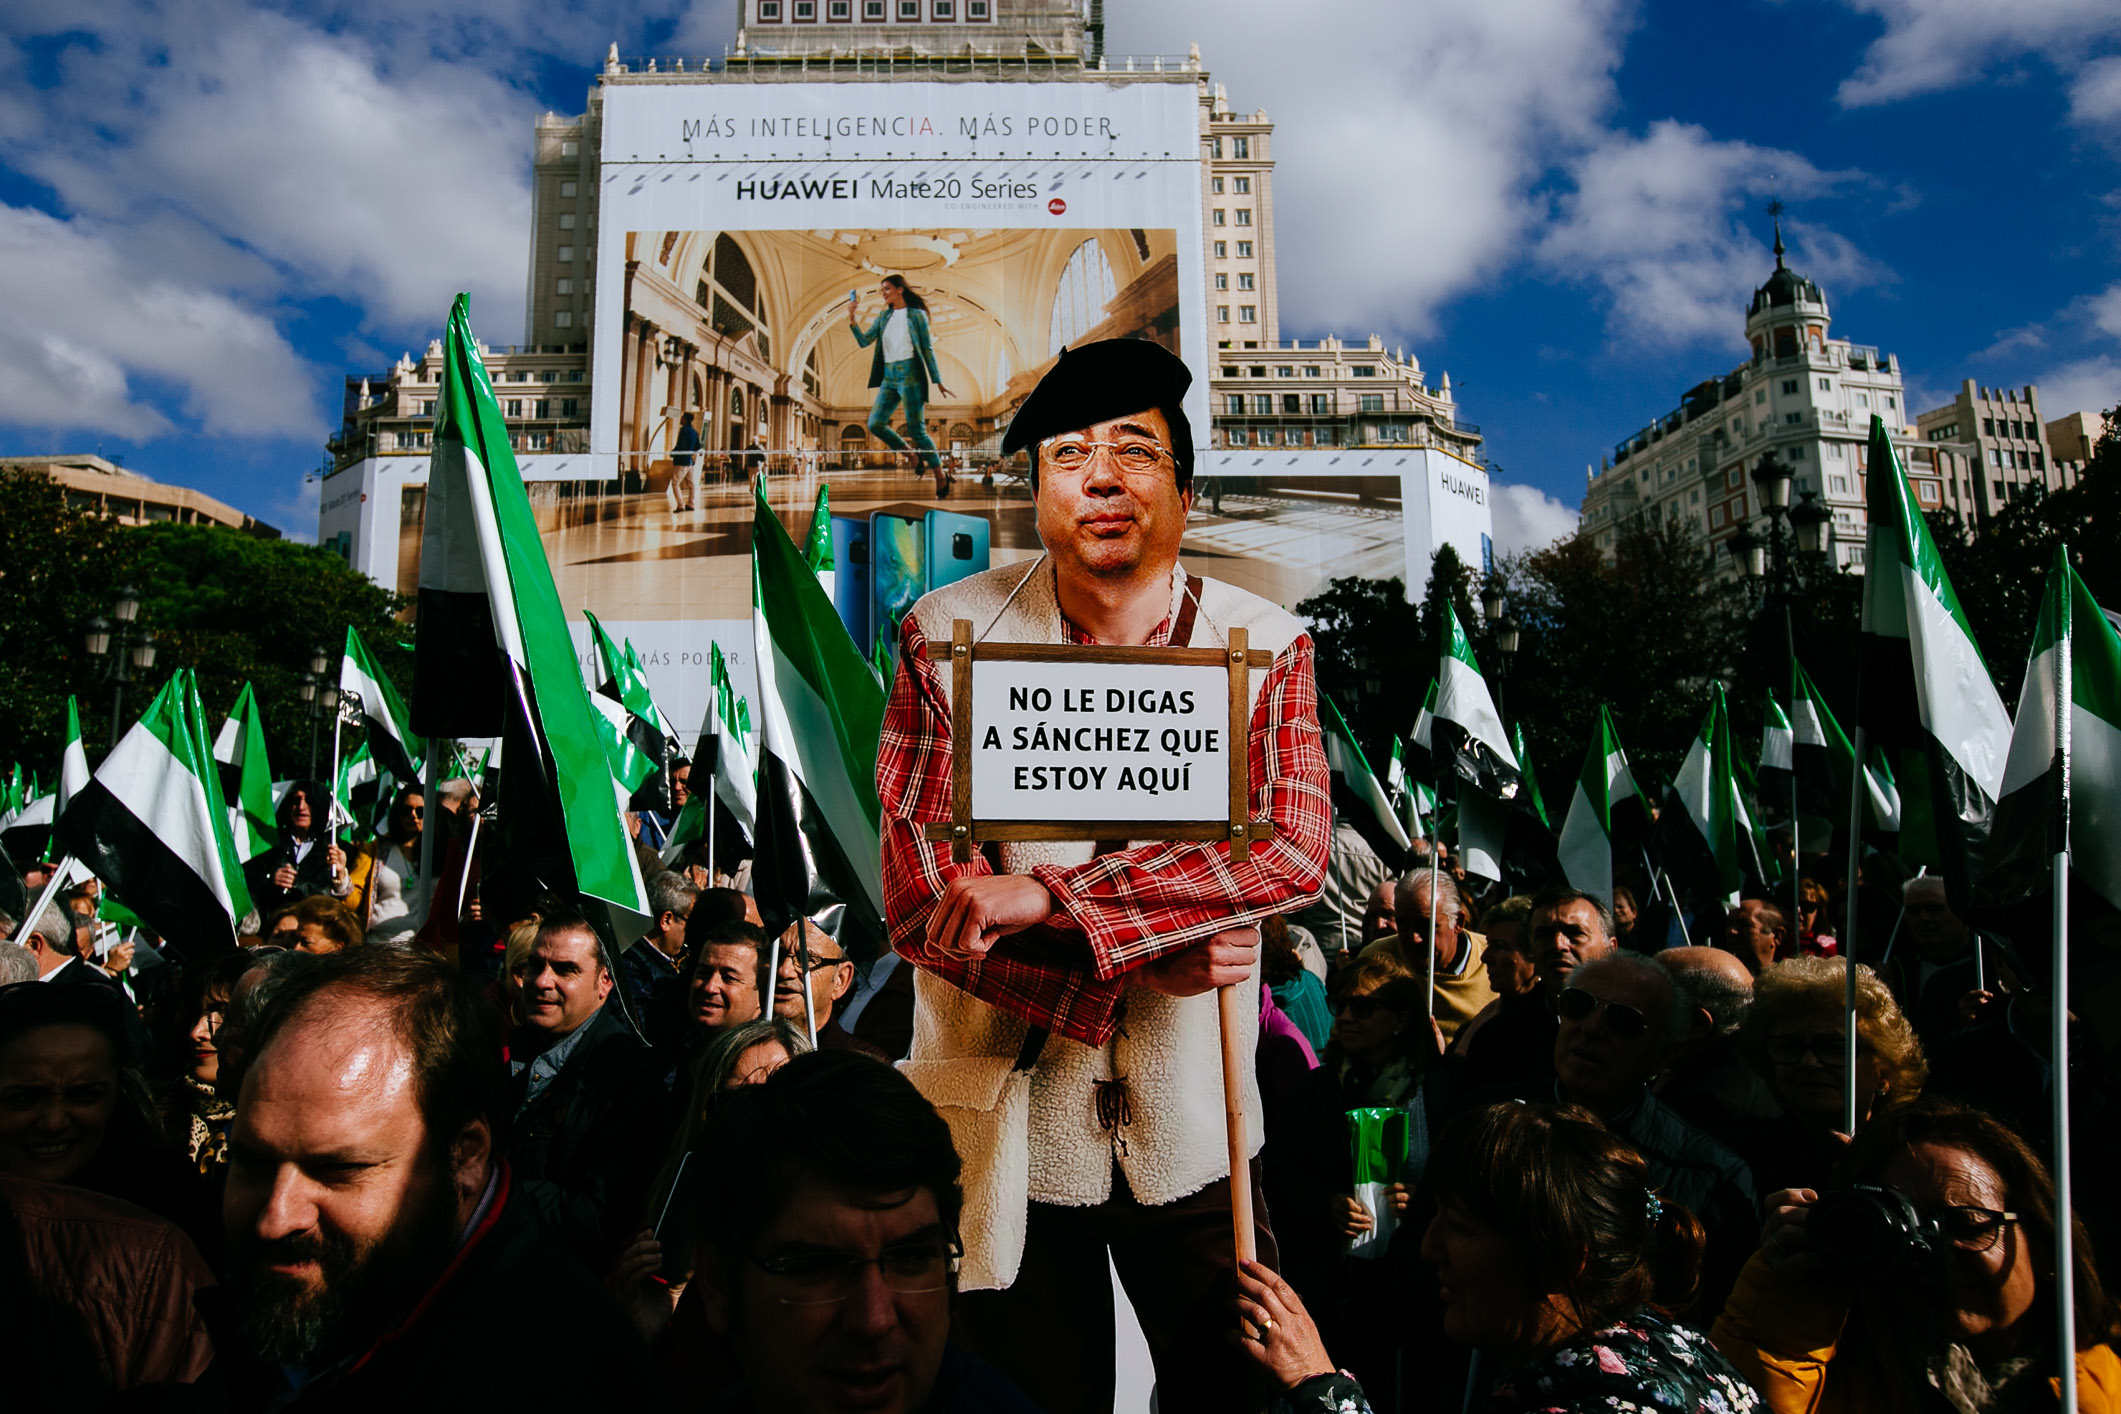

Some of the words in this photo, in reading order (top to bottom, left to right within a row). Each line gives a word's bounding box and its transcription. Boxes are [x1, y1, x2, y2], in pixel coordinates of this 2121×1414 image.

[682, 114, 736, 137] MÁS
[751, 116, 943, 136] INTELIGENCIA.
[960, 113, 1013, 136] MÁS
[1028, 116, 1121, 137] PODER.
[736, 180, 858, 200] HUAWEI
[871, 178, 962, 199] Mate20
[970, 177, 1038, 199] Series
[1440, 471, 1485, 506] HUAWEI
[682, 651, 746, 665] POR.
[1010, 687, 1051, 712] NO
[1064, 689, 1095, 712] LE
[1106, 689, 1195, 714] DIGAS
[983, 726, 1002, 749] A
[1012, 722, 1150, 752] SÁNCHEZ
[1160, 728, 1219, 757] QUE
[1014, 766, 1108, 790] ESTOY
[1117, 763, 1192, 795] AQUÍ
